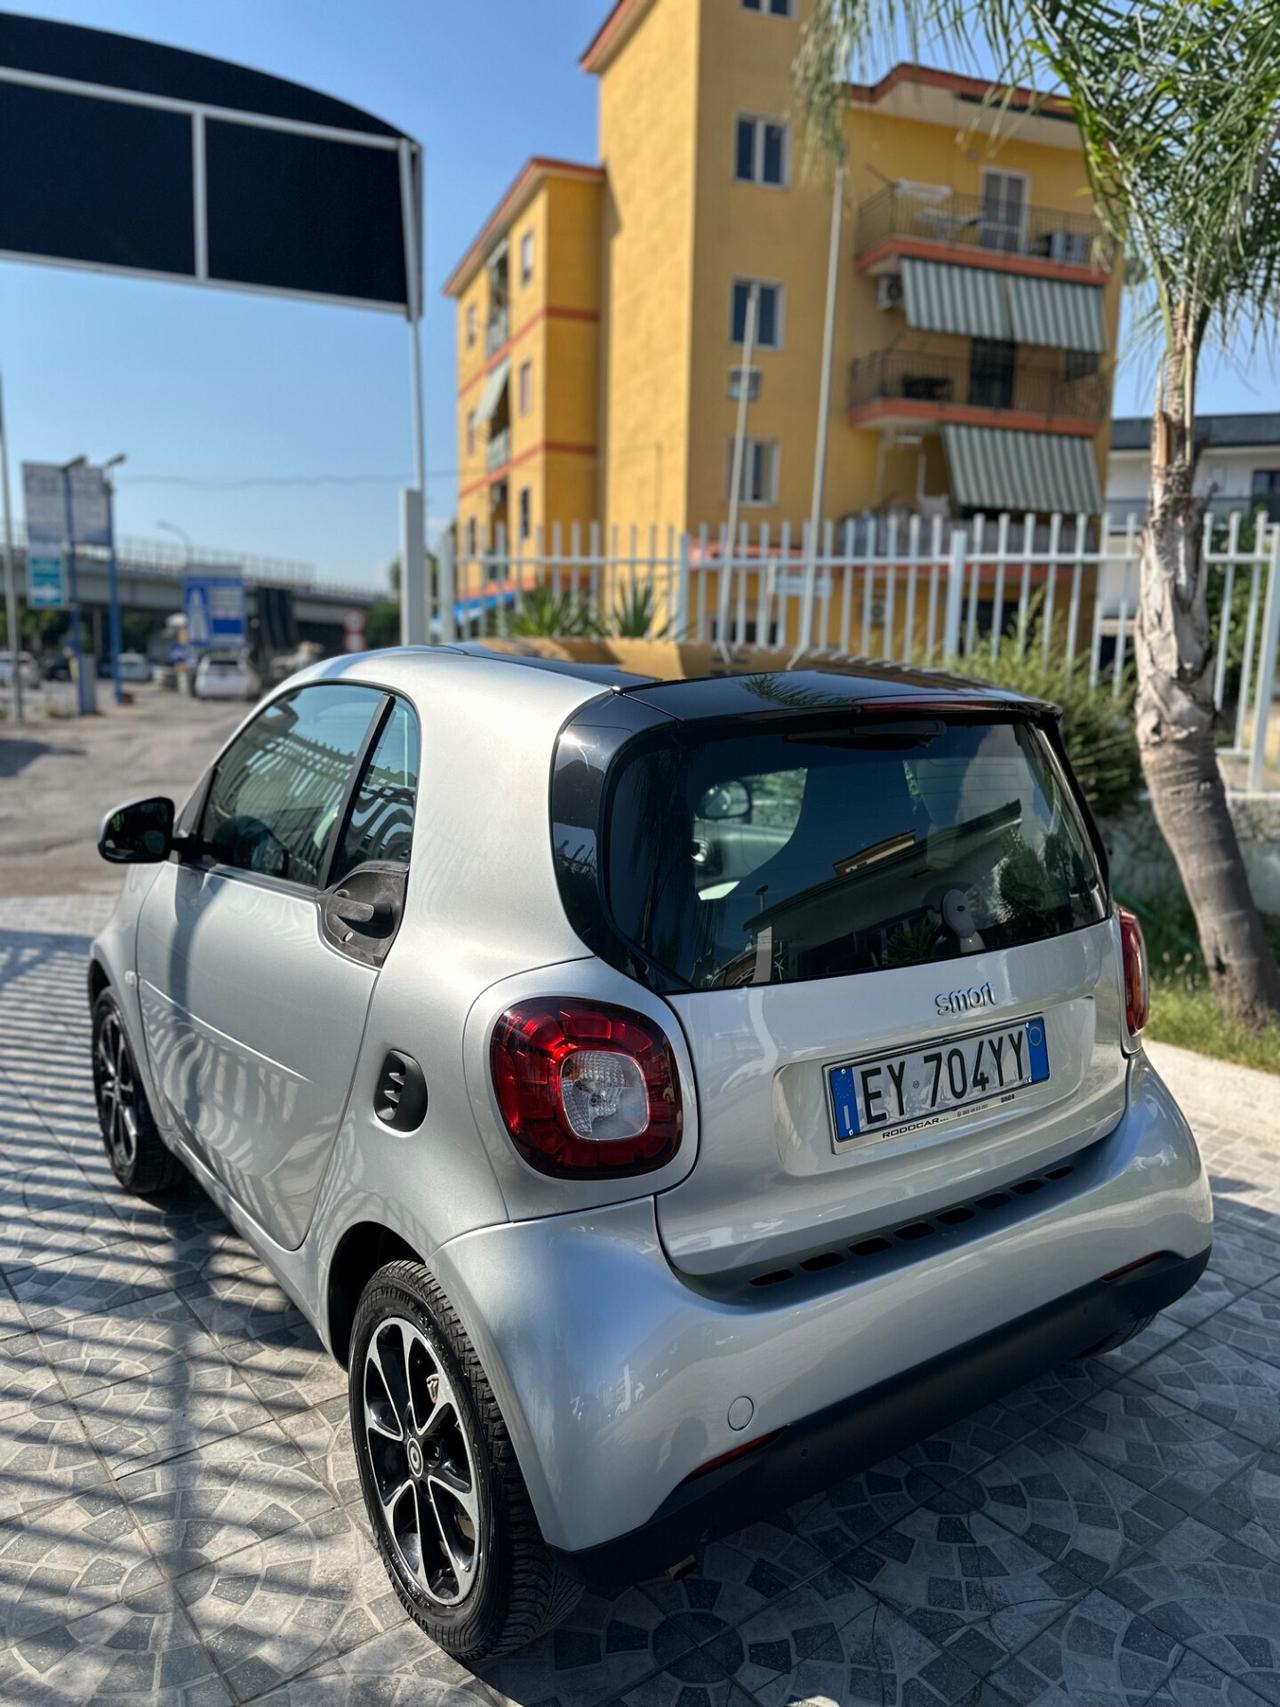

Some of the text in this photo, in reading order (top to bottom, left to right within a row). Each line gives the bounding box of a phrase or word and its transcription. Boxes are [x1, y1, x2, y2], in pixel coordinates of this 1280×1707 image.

[935, 981, 996, 1016] smart
[860, 1060, 906, 1125] EY
[923, 1030, 1024, 1109] 704YY
[882, 1117, 940, 1139] RODOCAR
